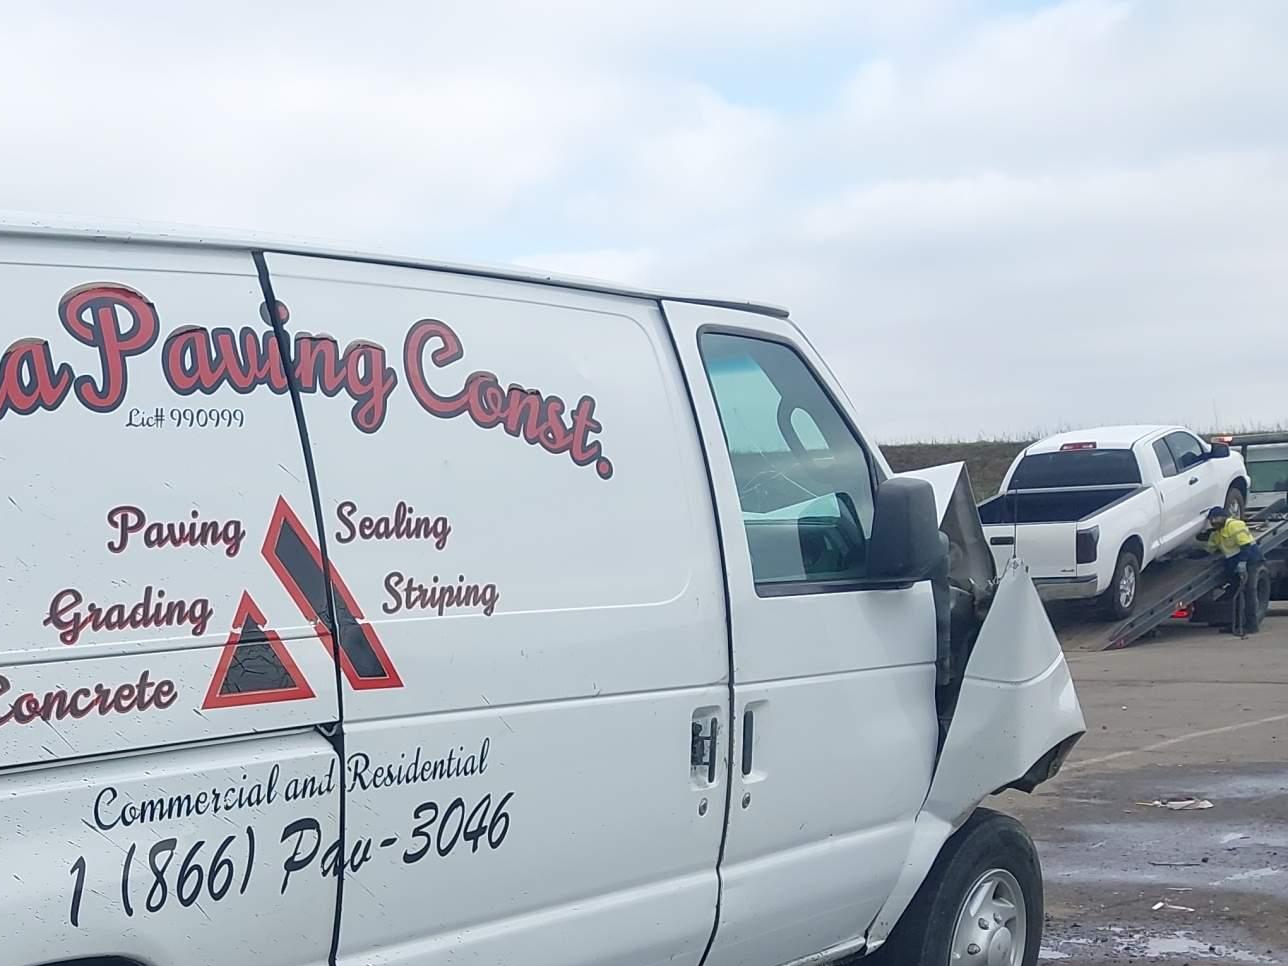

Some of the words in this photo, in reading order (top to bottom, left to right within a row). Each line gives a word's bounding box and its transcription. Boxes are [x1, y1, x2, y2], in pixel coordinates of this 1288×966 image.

[57, 281, 396, 433] Paving
[404, 318, 614, 480] Const.
[125, 407, 165, 428] Lic#
[170, 408, 245, 428] 990999
[107, 505, 246, 557] Paving
[335, 500, 452, 550] Sealing
[43, 586, 214, 645] Grading
[382, 571, 500, 617] Striping
[93, 764, 280, 831] Commercial
[285, 758, 335, 798] and
[346, 737, 490, 793] Residential
[69, 855, 86, 927] 1
[121, 826, 255, 917] (866)
[279, 792, 515, 895] Pav-3046
